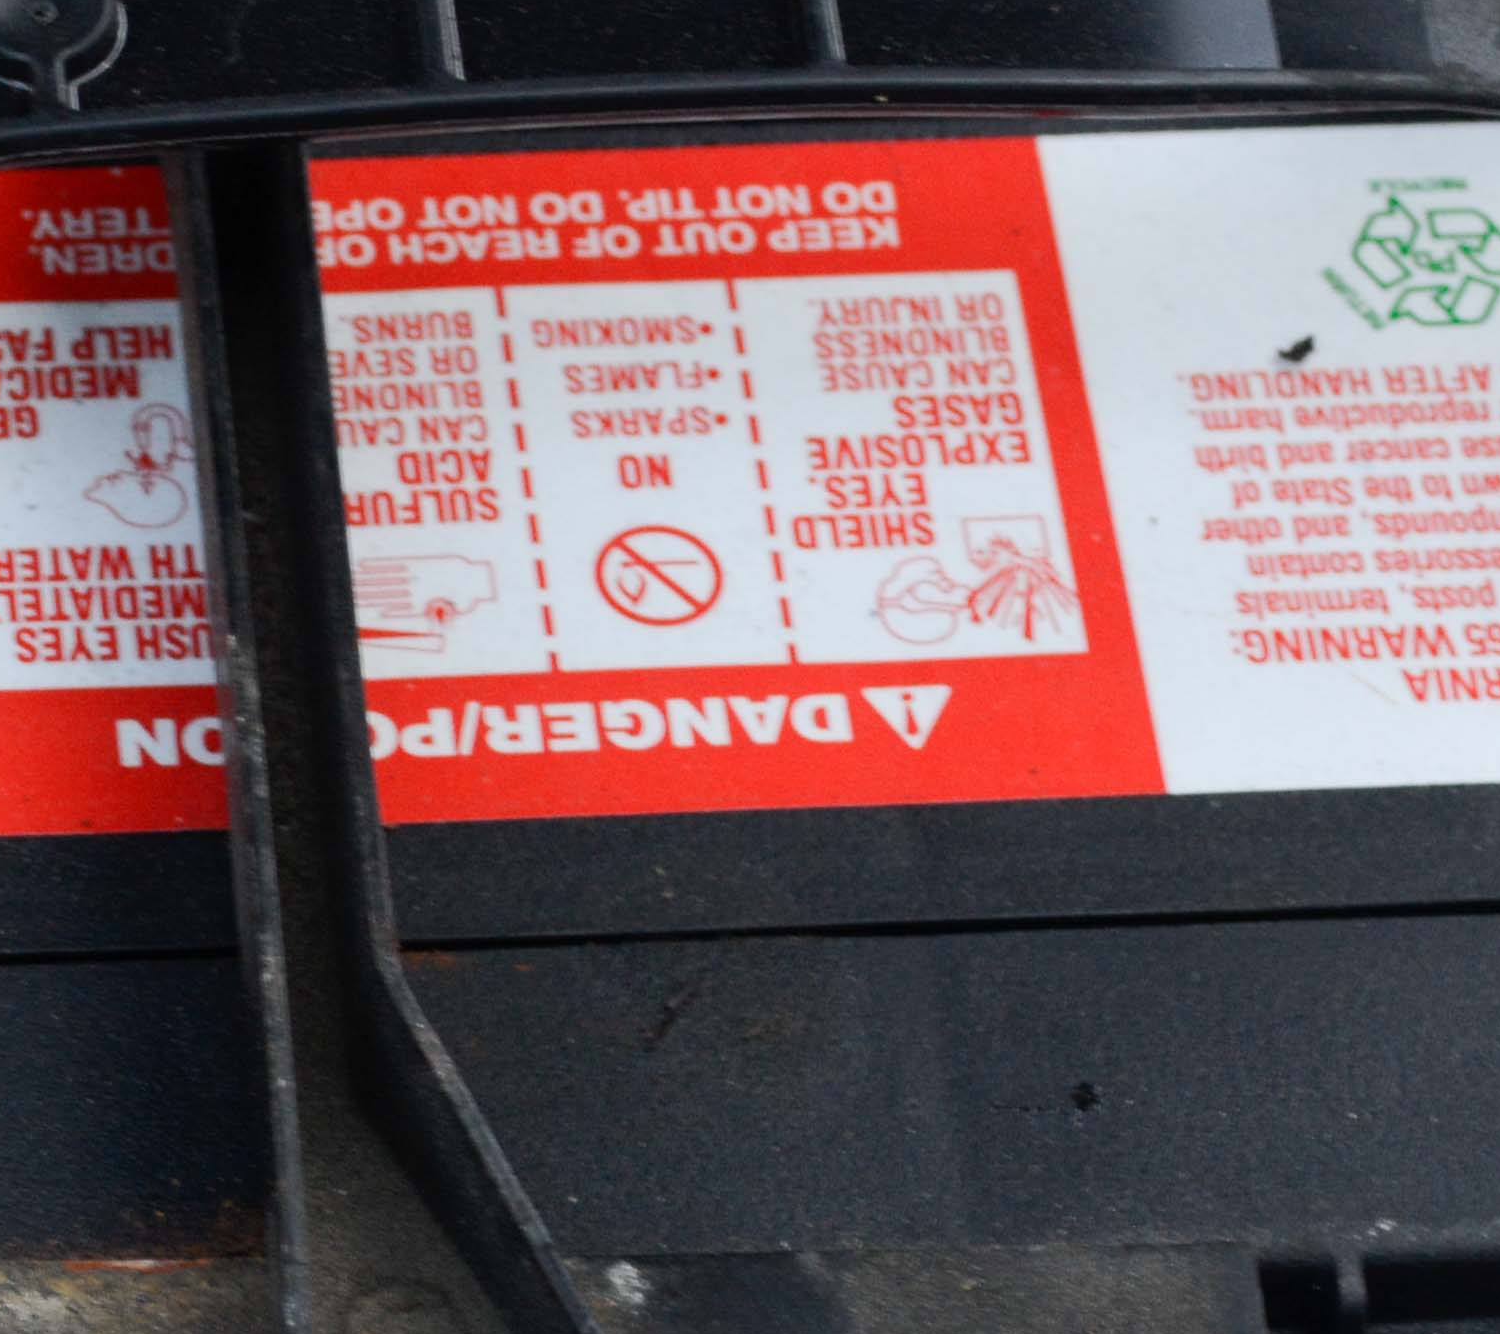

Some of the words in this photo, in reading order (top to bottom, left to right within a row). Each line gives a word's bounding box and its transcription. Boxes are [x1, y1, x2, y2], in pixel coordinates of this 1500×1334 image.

[415, 193, 519, 230] NOT
[529, 190, 604, 225] DO
[617, 185, 699, 221] TIP.
[709, 183, 810, 219] NOT
[822, 180, 896, 213] DO
[21, 206, 172, 240] TERY.
[310, 196, 404, 232] OPE
[313, 232, 377, 267] OF
[388, 225, 560, 265] REACH
[570, 223, 641, 259] OF
[652, 219, 757, 256] OUT
[769, 215, 899, 252] KEEP
[28, 241, 177, 276] DREN.
[807, 296, 943, 327] INJURY.
[951, 293, 1001, 323] OR
[70, 324, 172, 361] HELP
[339, 311, 474, 343] BURNS.
[531, 315, 697, 348] SMOKING
[814, 326, 1009, 359] BLINDNESS
[327, 347, 416, 379] SEVE
[430, 345, 477, 375] OR
[822, 362, 930, 391] CAUSE
[948, 358, 1016, 387] CAN
[562, 361, 703, 393] FLAMES
[1176, 369, 1372, 401] HANDLING.
[1382, 364, 1491, 395] AFTER
[331, 380, 483, 412] BLINDNE
[892, 392, 1022, 428] GASES
[418, 415, 488, 442] CAN
[570, 406, 711, 437] SPARKS
[1188, 407, 1283, 434] harm.
[1292, 396, 1490, 432] reproductive
[334, 417, 405, 447] CAU
[806, 428, 1030, 470] EXPLOSIVE
[1193, 444, 1266, 475] birth
[1277, 441, 1333, 470] and
[1345, 437, 1450, 465] cancer
[396, 449, 492, 484] ACID
[619, 454, 672, 489] NO
[807, 473, 926, 510] EYES.
[1232, 480, 1261, 509] of
[1271, 477, 1352, 508] State
[1363, 476, 1413, 503] the
[1422, 473, 1452, 501] to
[342, 488, 500, 526] SULFUR
[791, 510, 934, 548] SHIELD
[1201, 517, 1281, 546] other
[1292, 515, 1348, 543] and
[150, 544, 204, 580] TH
[1247, 551, 1364, 581] contain
[1235, 588, 1389, 619] terminals
[1398, 580, 1496, 614] posts,
[14, 625, 120, 663] EYES
[135, 623, 213, 661] USH
[1229, 625, 1455, 664] WARNING:
[116, 693, 854, 768] DANGER/PON
